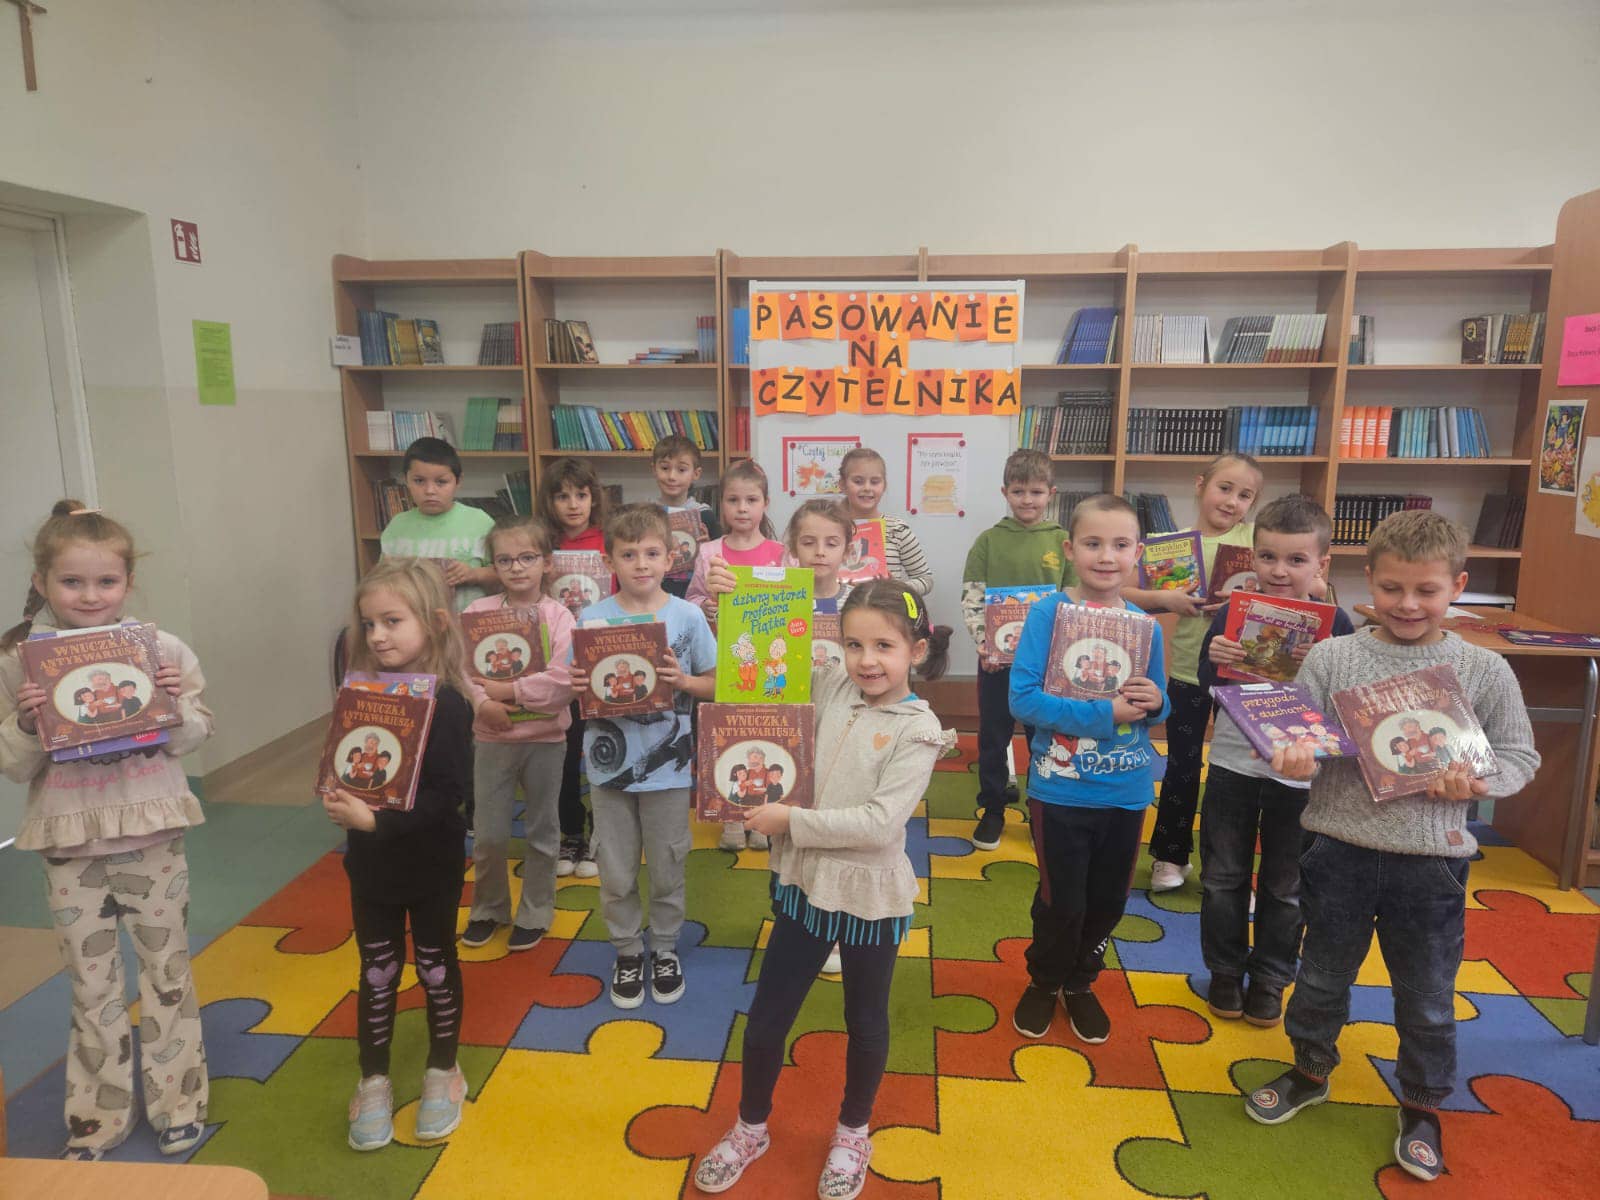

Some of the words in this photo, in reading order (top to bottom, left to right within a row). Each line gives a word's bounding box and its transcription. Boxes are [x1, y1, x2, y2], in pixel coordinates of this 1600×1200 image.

[757, 300, 1014, 334] PASOWANIE
[850, 340, 903, 368] NA
[758, 374, 1017, 407] CZYTELNIKA
[54, 637, 129, 656] WNUCZKA
[356, 699, 406, 716] WNUCZKA
[725, 715, 788, 727] WNUCZKA
[711, 727, 802, 737] ANTYKWARIUSZA
